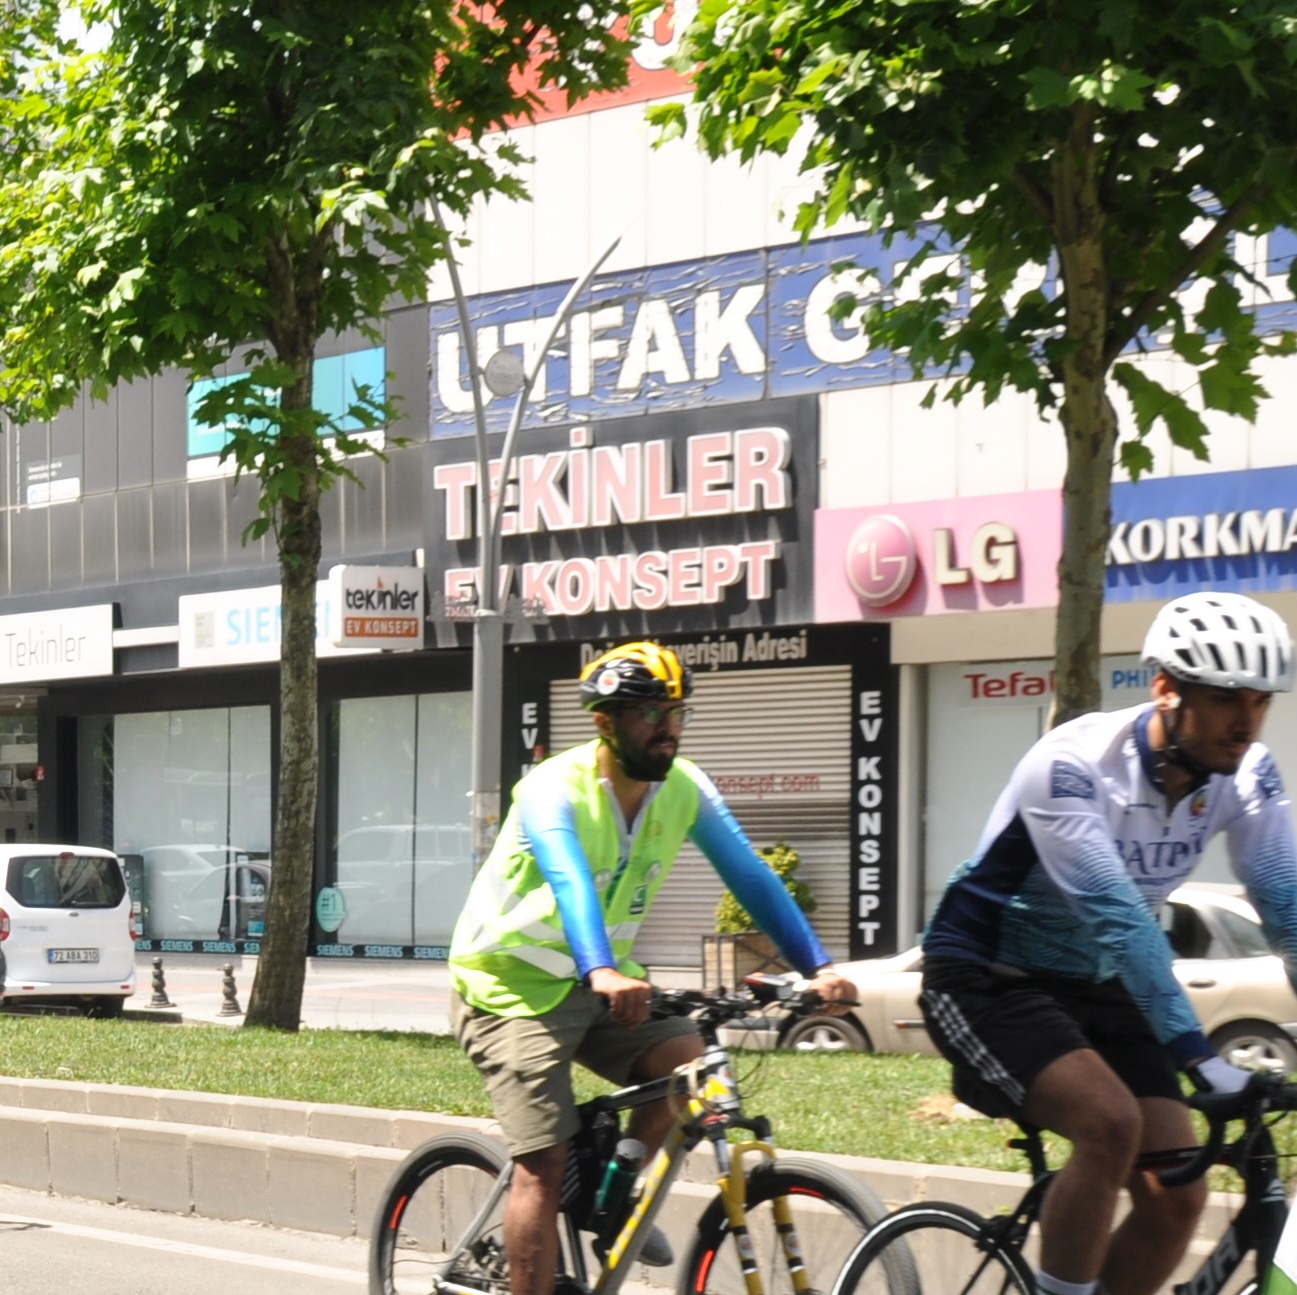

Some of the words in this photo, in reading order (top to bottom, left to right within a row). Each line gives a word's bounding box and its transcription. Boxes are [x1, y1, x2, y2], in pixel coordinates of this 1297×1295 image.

[434, 427, 791, 541] TEKİNLER
[933, 521, 1019, 586] LG
[523, 539, 777, 617] KONSEPT
[346, 580, 419, 611] tekinler
[345, 619, 362, 637] EV
[365, 617, 418, 635] KONSEPT
[5, 624, 86, 668] Tekinler
[743, 629, 808, 663] Adresi
[160, 940, 194, 952] SIEMENS
[202, 941, 236, 953] SIEMENS
[316, 944, 354, 956] SIEMENS
[364, 945, 403, 958] SIEMENS
